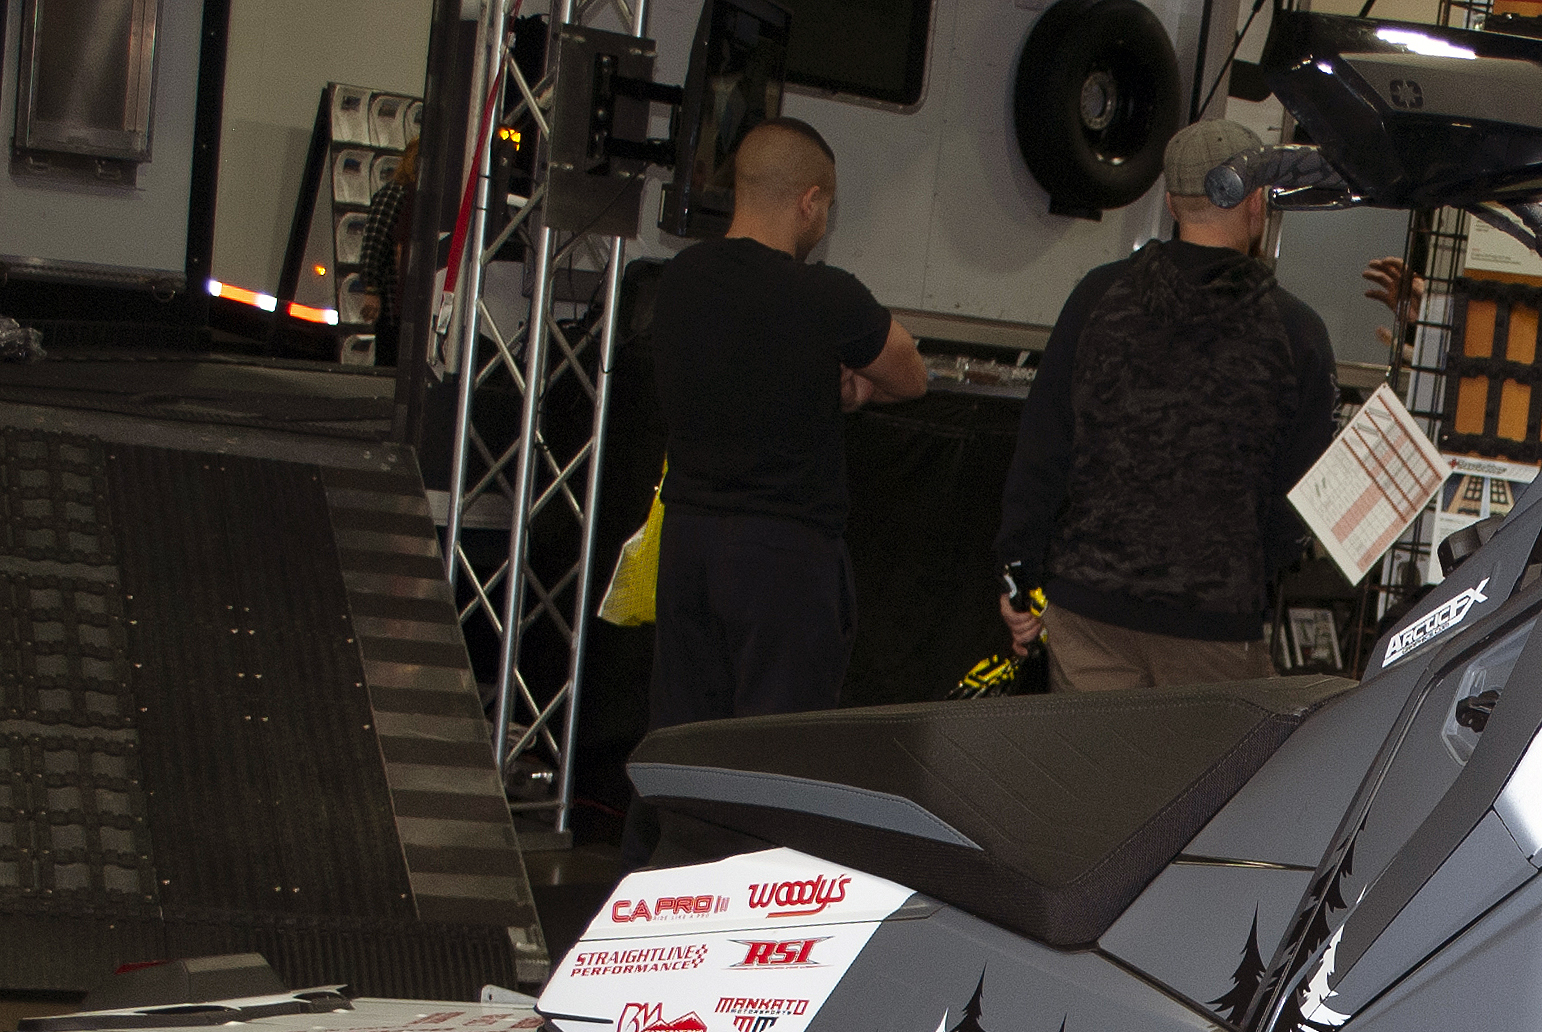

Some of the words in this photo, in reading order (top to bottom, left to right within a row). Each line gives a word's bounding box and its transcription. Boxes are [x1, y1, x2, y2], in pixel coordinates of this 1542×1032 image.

[574, 944, 697, 968] STRAIGHTLINE
[737, 938, 822, 968] RSI
[570, 960, 693, 977] PERFORMANCE
[713, 997, 810, 1016] MANKATO
